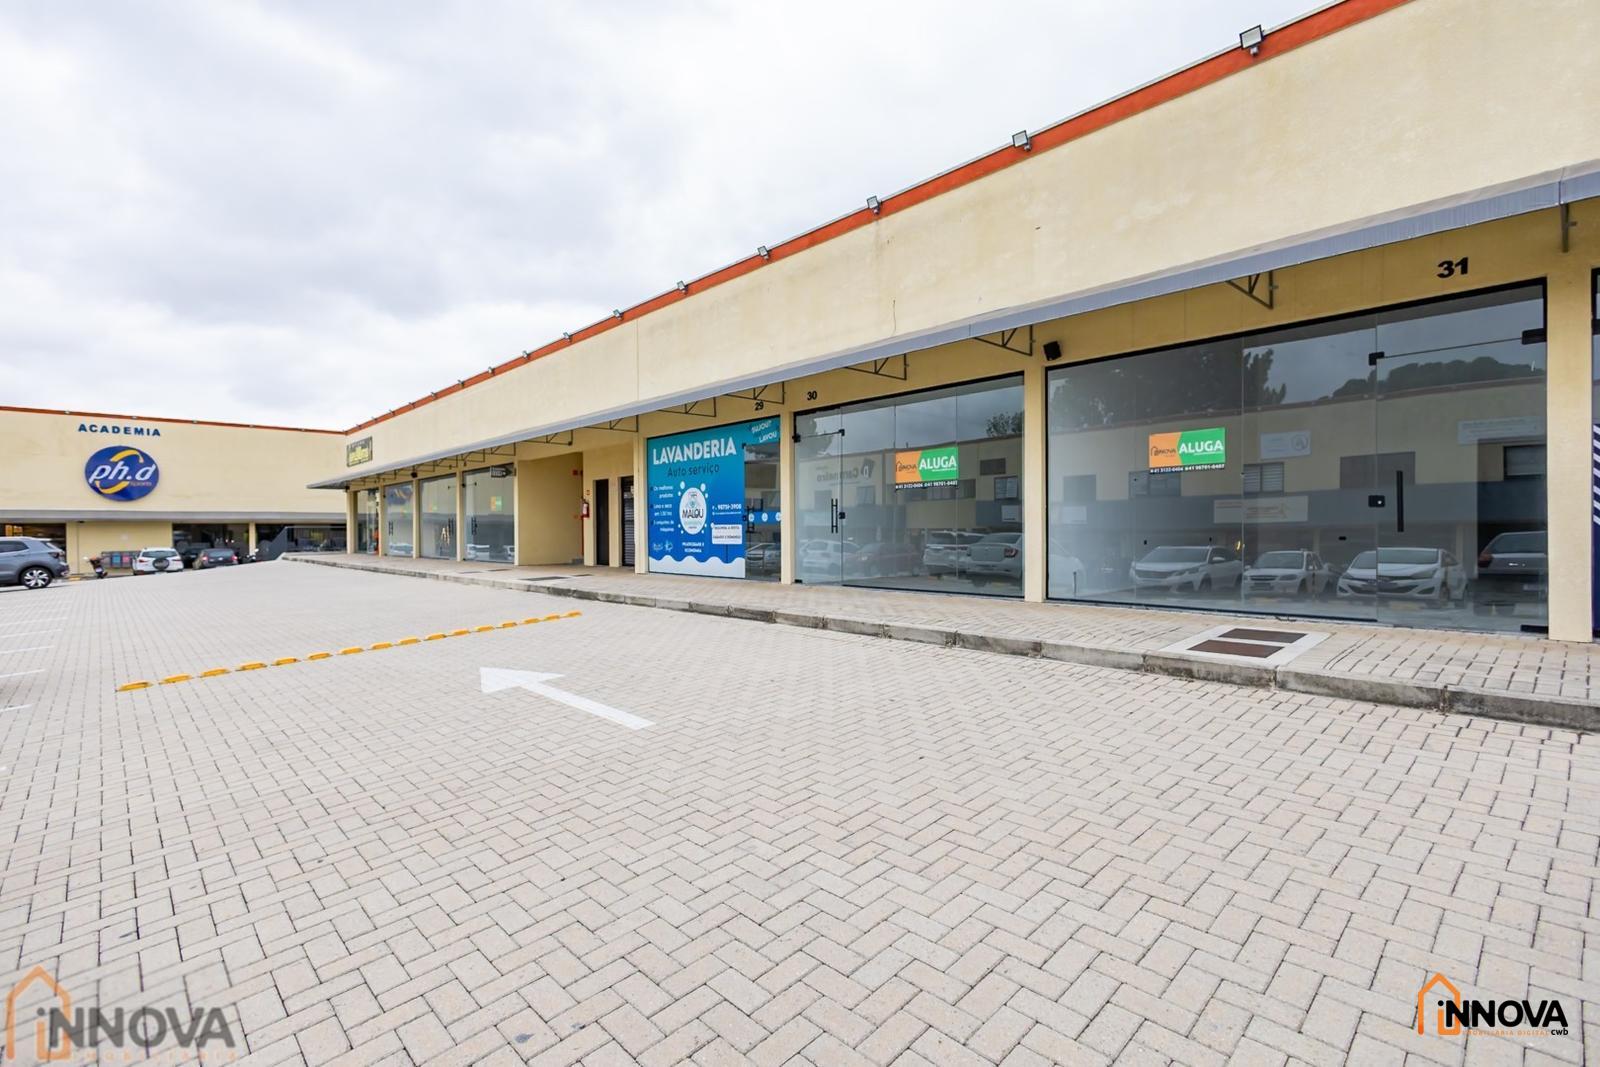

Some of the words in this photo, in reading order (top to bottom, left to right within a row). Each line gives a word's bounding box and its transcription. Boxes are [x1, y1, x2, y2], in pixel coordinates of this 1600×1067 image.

[1437, 256, 1469, 279] 31
[807, 391, 817, 400] 30
[754, 401, 764, 411] 29
[78, 423, 161, 436] ACADEMIA
[653, 437, 737, 464] LAVANDERIA
[1179, 440, 1224, 453] ALUGA
[919, 455, 957, 470] ALUGA
[88, 461, 157, 484] ph.d
[667, 466, 686, 478] Auto
[688, 463, 720, 476] serviço
[682, 508, 704, 519] MALOU
